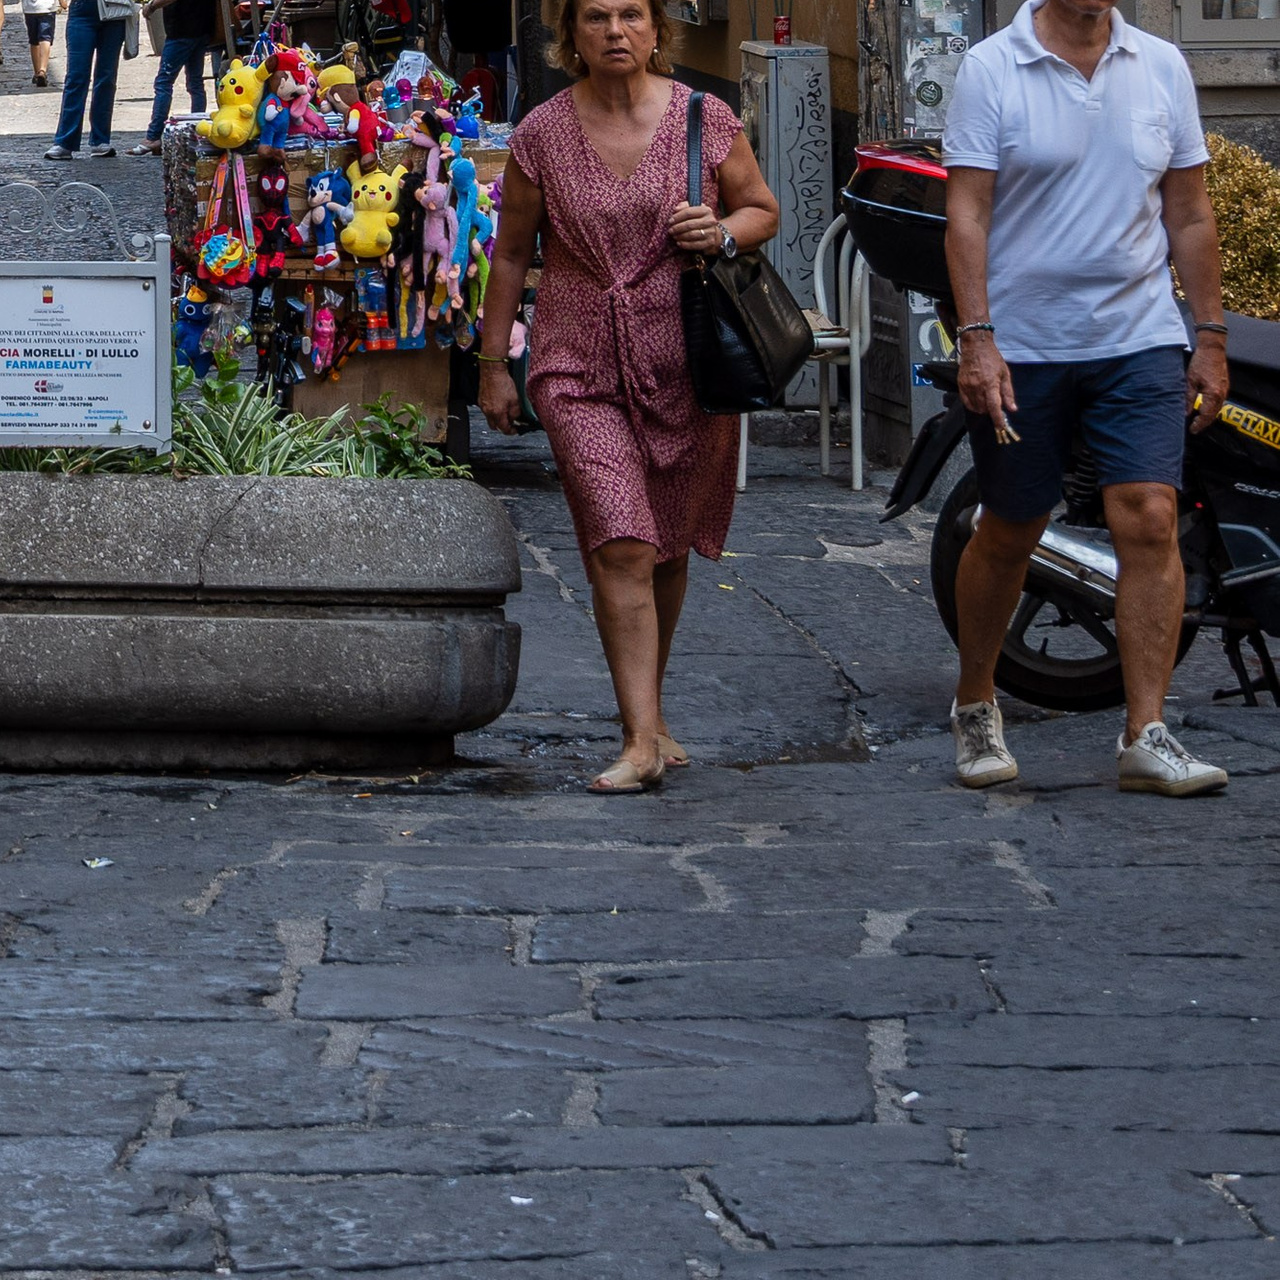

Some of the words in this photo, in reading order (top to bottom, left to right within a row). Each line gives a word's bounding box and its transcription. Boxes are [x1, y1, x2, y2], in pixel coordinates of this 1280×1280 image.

[23, 348, 75, 357] MORELLI
[85, 349, 98, 357] DI
[101, 349, 139, 358] LULLO
[5, 360, 93, 369] FARMABEAUTY
